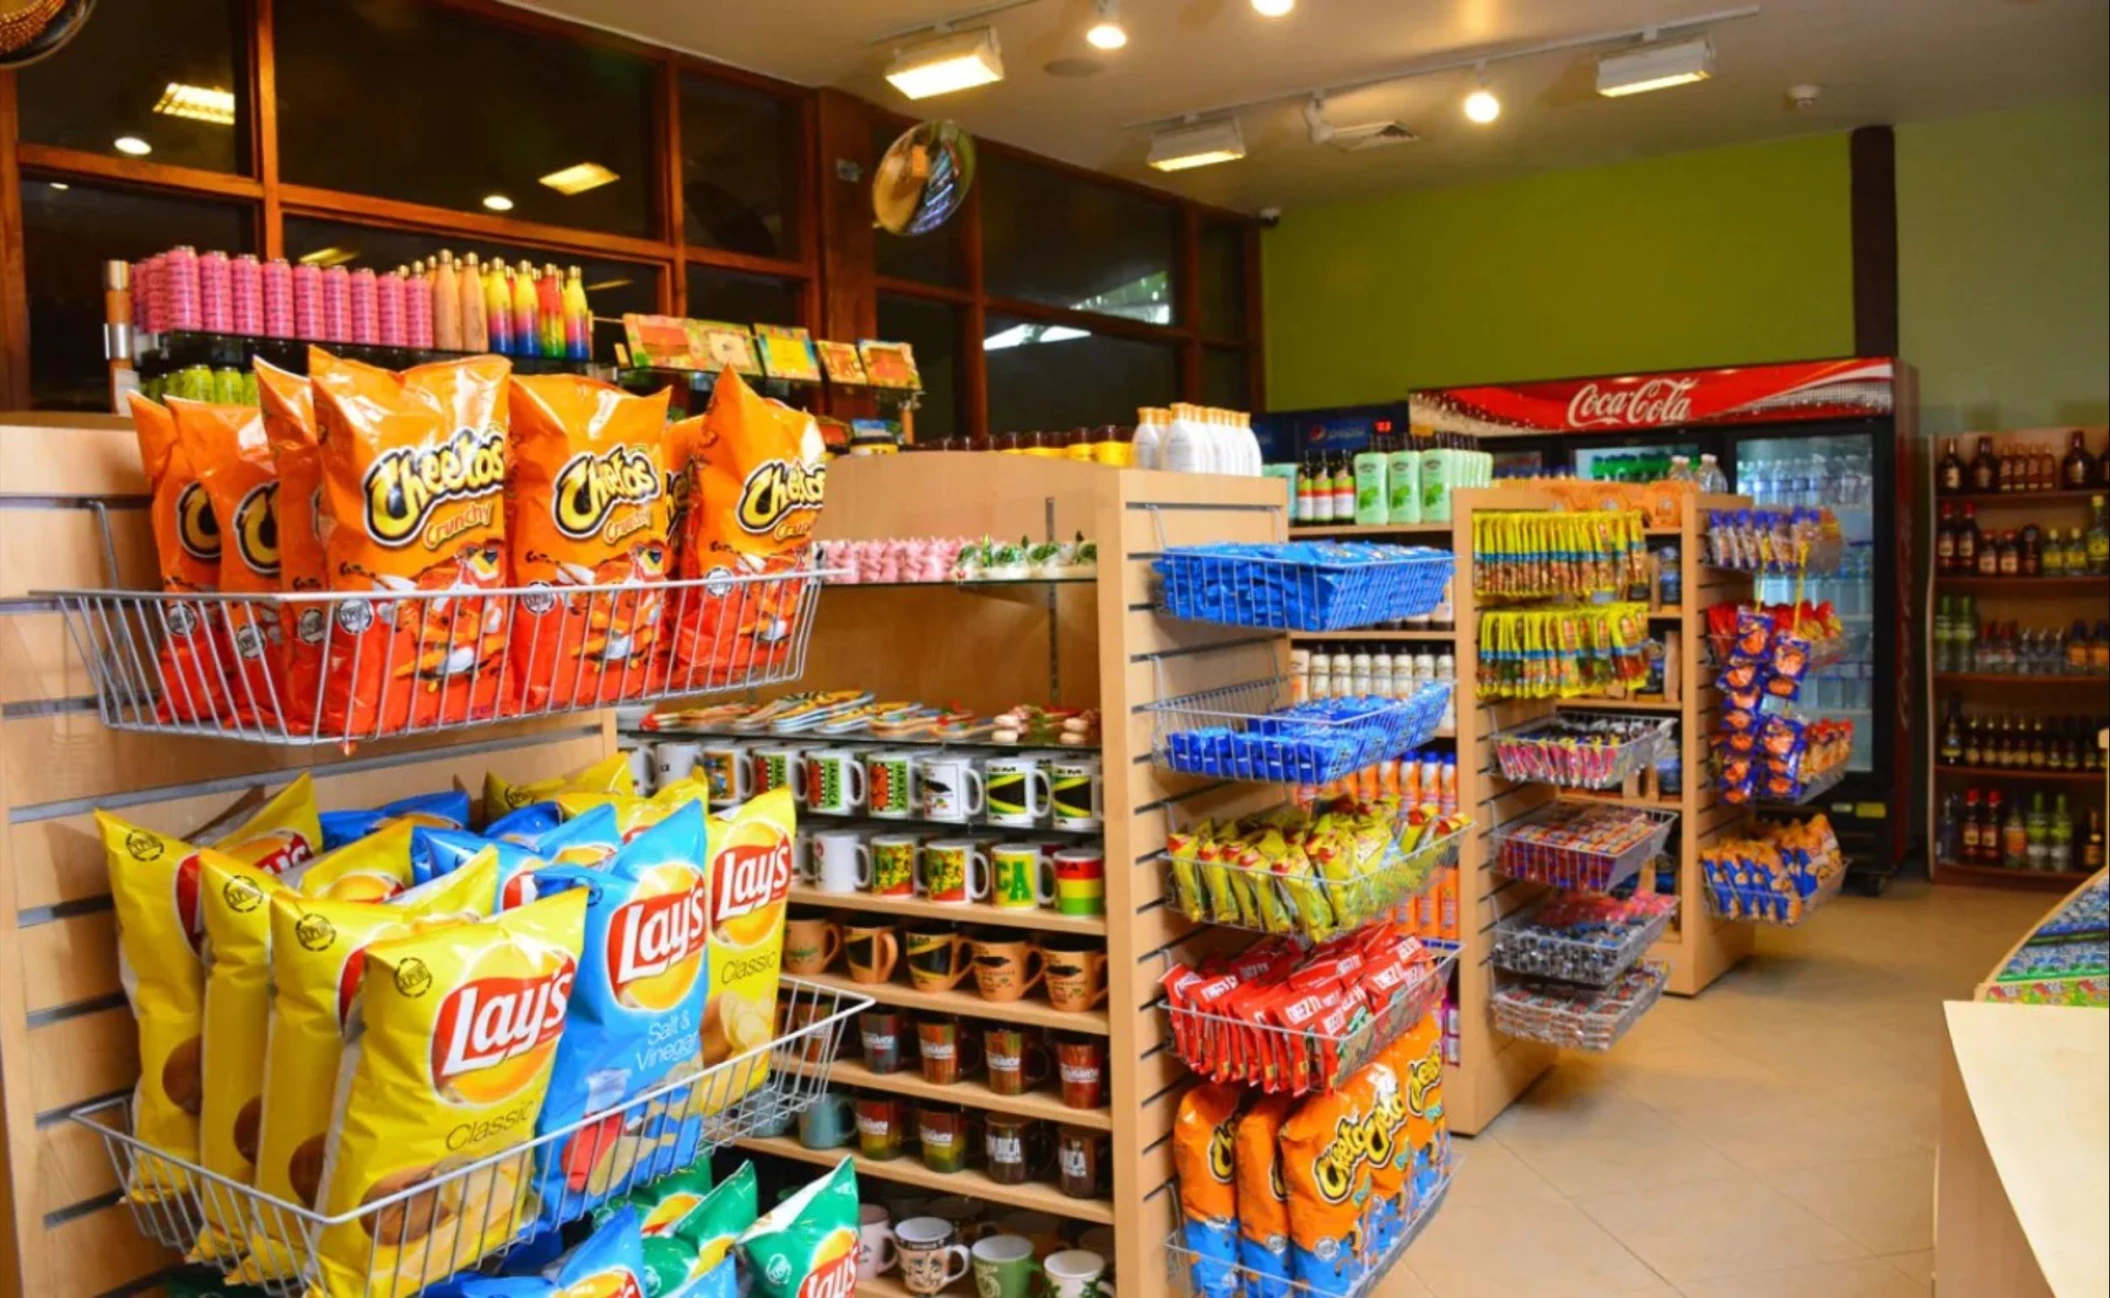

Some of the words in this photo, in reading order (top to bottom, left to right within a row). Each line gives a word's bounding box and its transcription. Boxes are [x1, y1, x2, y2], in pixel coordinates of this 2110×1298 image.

[1567, 377, 1698, 428] Coca-Cola
[423, 501, 493, 549] Crunchy
[715, 841, 789, 922] Lay's
[617, 885, 704, 984] Lay's
[720, 949, 777, 985] Classic
[441, 970, 573, 1077] Lay's
[647, 1018, 681, 1046] Salt
[635, 1030, 699, 1073] Vinegar
[445, 1099, 535, 1152] Classic
